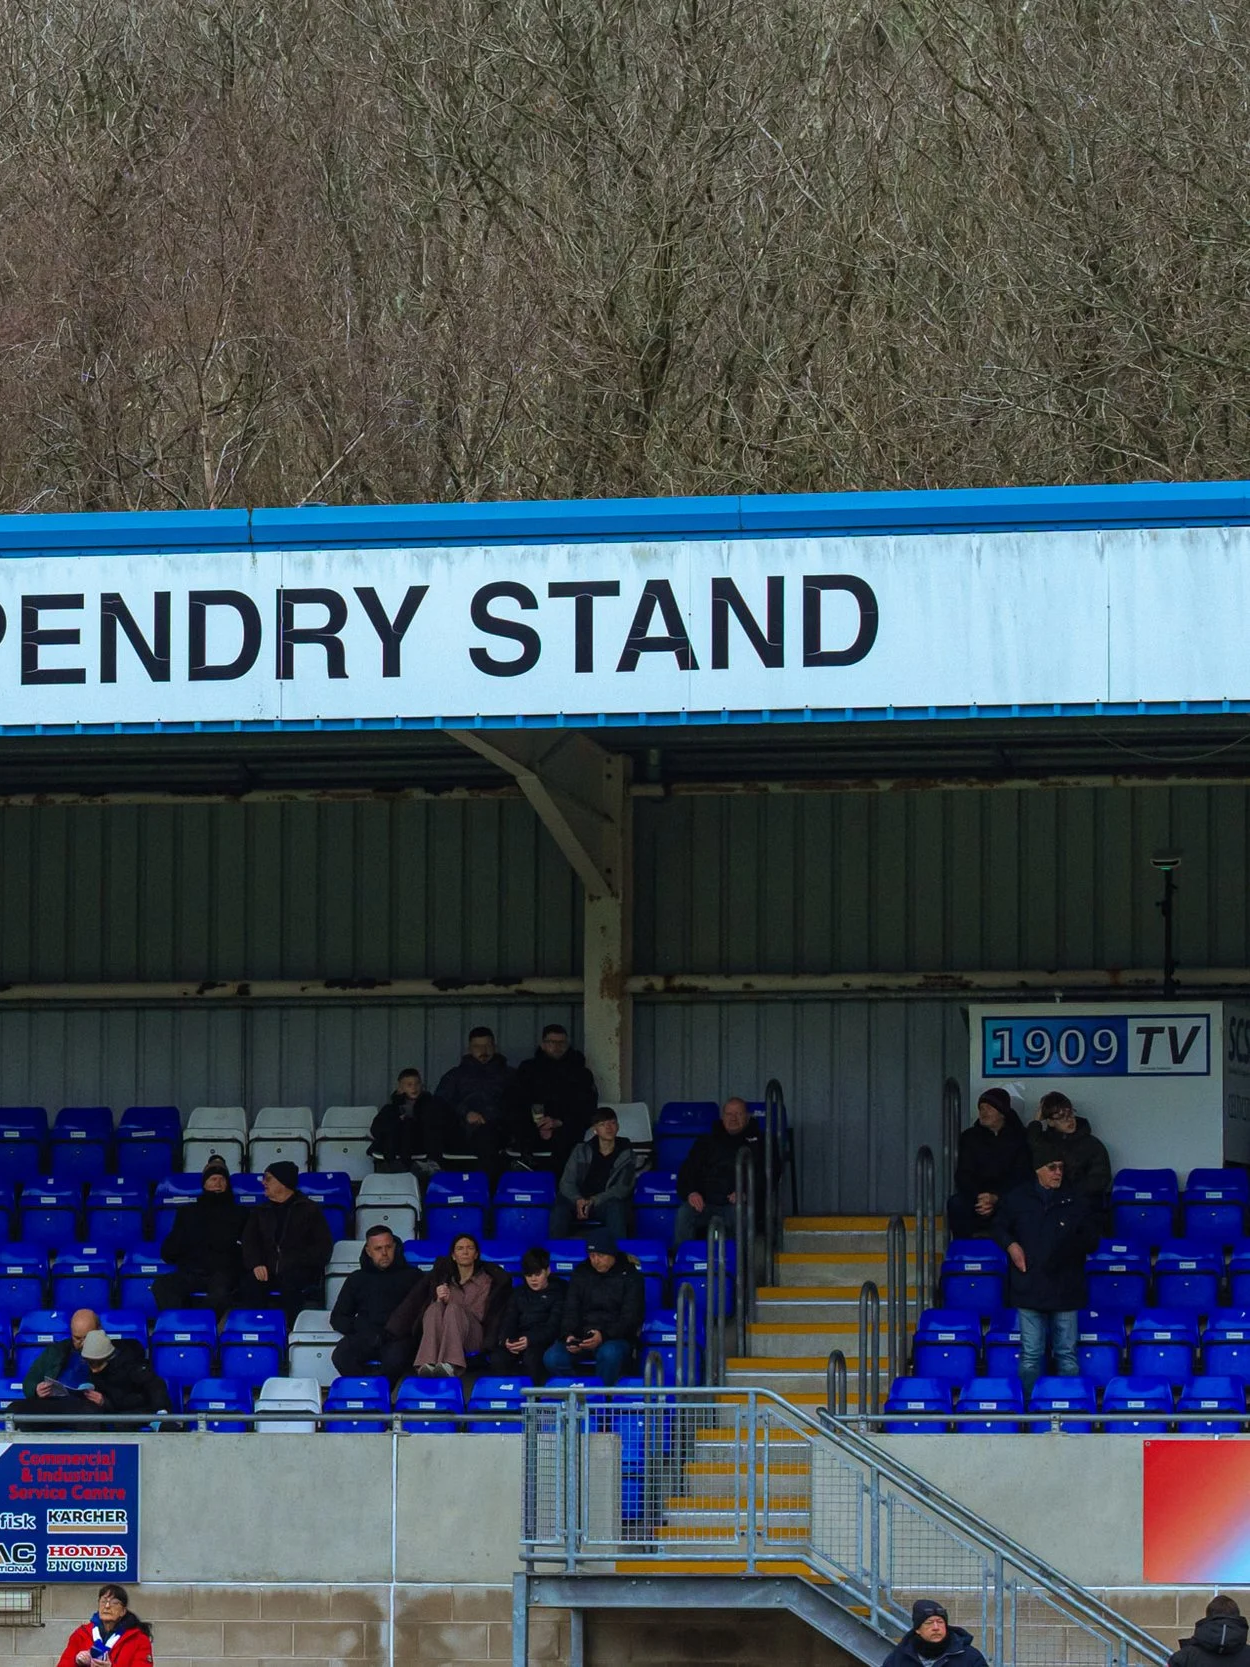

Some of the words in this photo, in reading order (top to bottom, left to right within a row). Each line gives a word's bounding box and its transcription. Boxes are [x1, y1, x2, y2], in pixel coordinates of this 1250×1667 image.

[469, 574, 879, 678] STAND
[993, 1027, 1120, 1067] 1909
[1136, 1026, 1202, 1064] TV
[19, 1449, 116, 1466] Commercial
[21, 1467, 33, 1482] &
[37, 1467, 114, 1482] Industrial
[8, 1485, 67, 1500] Service
[71, 1485, 126, 1500] Centre
[48, 1546, 126, 1556] HONDA
[48, 1561, 127, 1571] ENGINES
